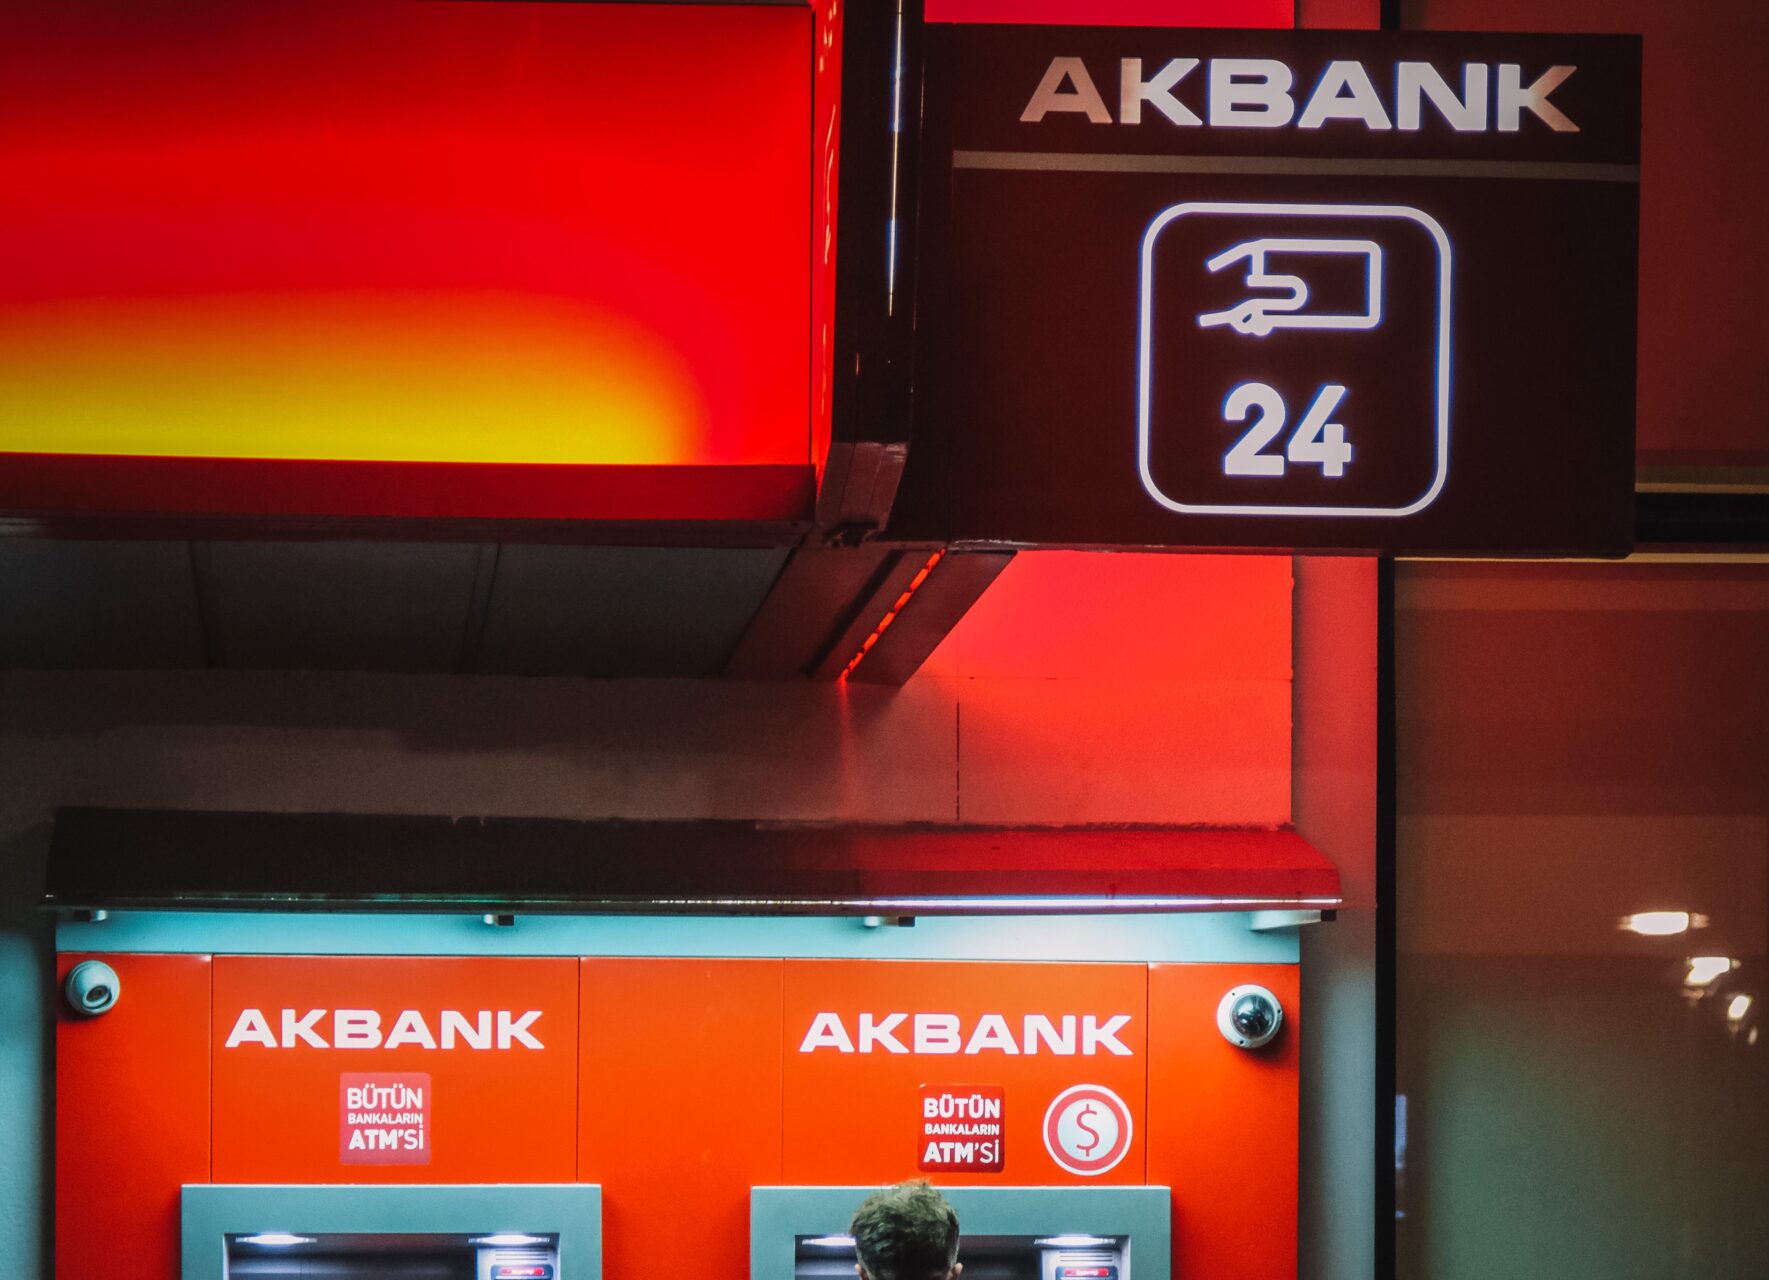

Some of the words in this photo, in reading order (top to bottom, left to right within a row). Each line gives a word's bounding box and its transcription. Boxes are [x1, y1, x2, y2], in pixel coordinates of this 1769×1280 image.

[1019, 56, 1581, 132] AKBANK
[1224, 382, 1352, 477] 24
[225, 1009, 545, 1049] AKBANK
[799, 1012, 1134, 1056] AKBANK
[347, 1083, 423, 1110] BÜTÜN
[923, 1093, 1000, 1119] BÜTÜN
[347, 1113, 423, 1125] BANKALARIN
[924, 1123, 1000, 1136] BANKALARIN
